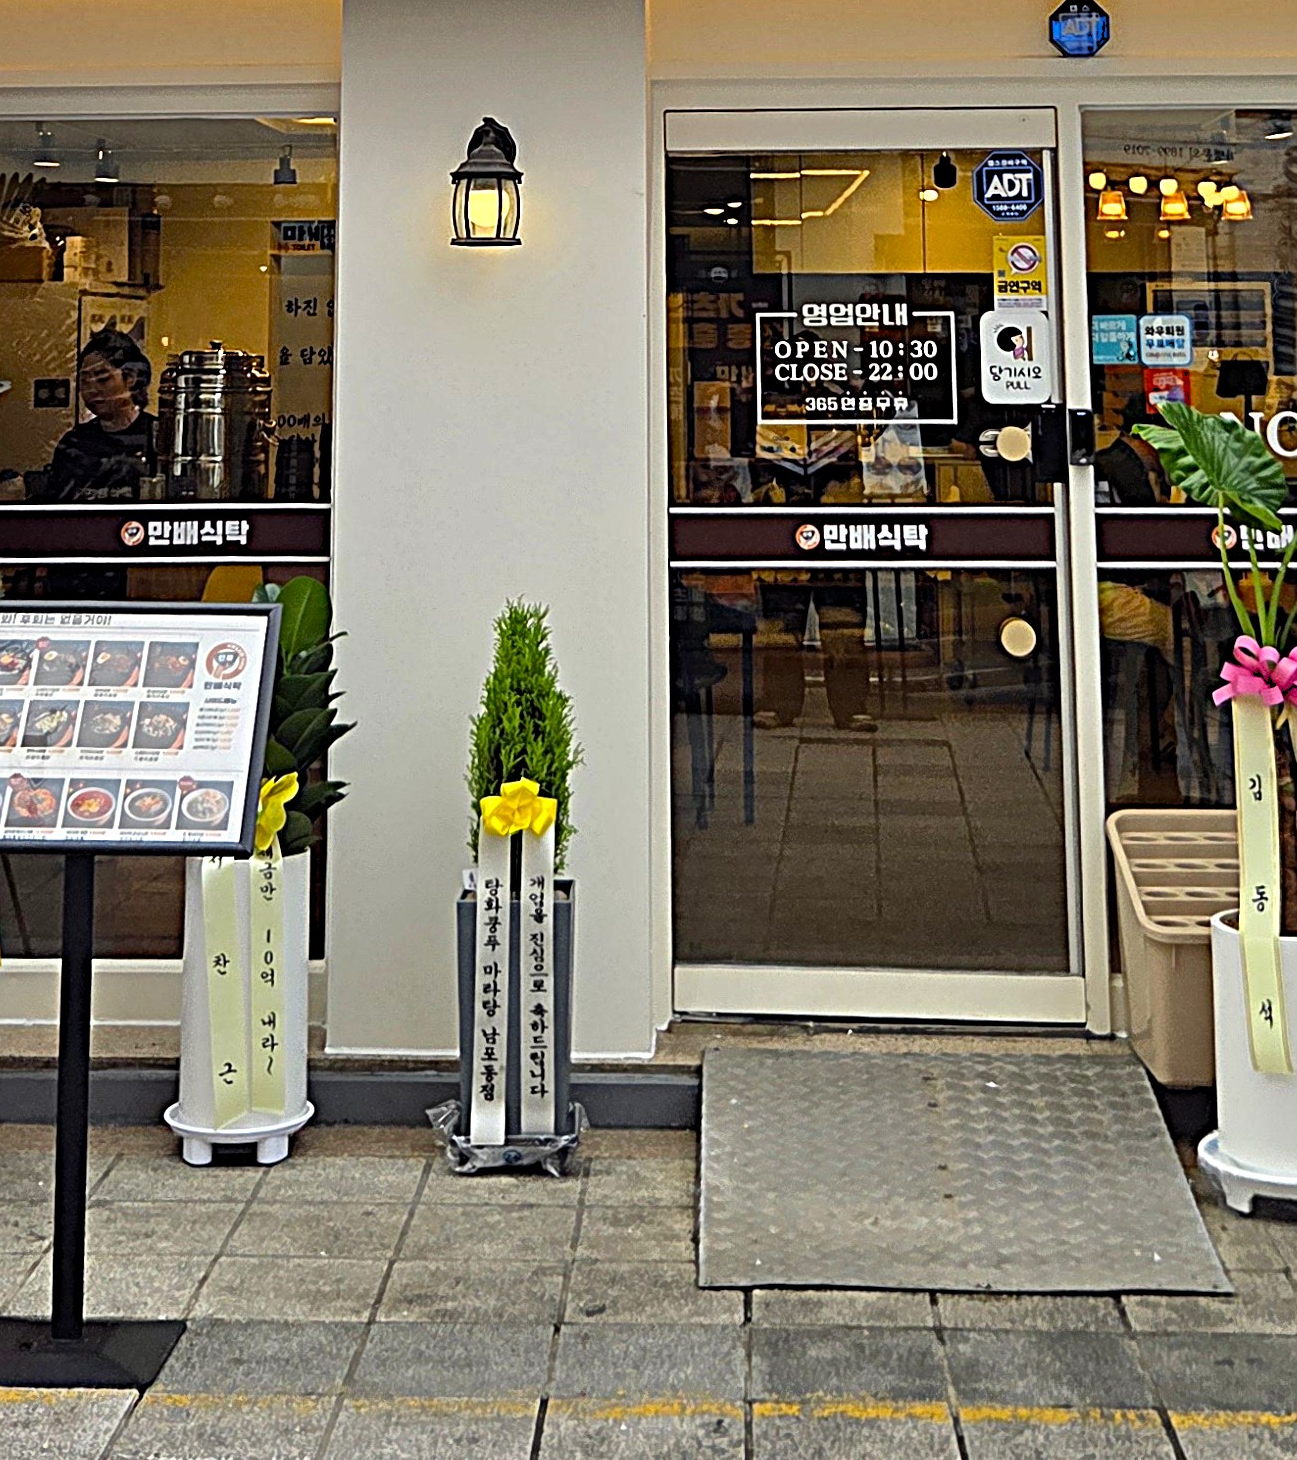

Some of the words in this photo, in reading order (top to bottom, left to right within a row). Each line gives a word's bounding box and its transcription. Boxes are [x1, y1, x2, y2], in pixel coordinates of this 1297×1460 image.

[985, 173, 1033, 198] ADT
[998, 280, 1042, 293] 금연구역
[802, 303, 908, 327] 영업안내
[774, 340, 848, 358] OPEN
[774, 363, 848, 381] CLOSE
[989, 365, 1043, 382] 당기시오
[1006, 380, 1030, 390] PULL
[148, 520, 249, 546] 만배식탁
[824, 524, 929, 551] 만배식탁
[529, 932, 548, 993] 진심으로
[482, 961, 501, 1018] 마라탕
